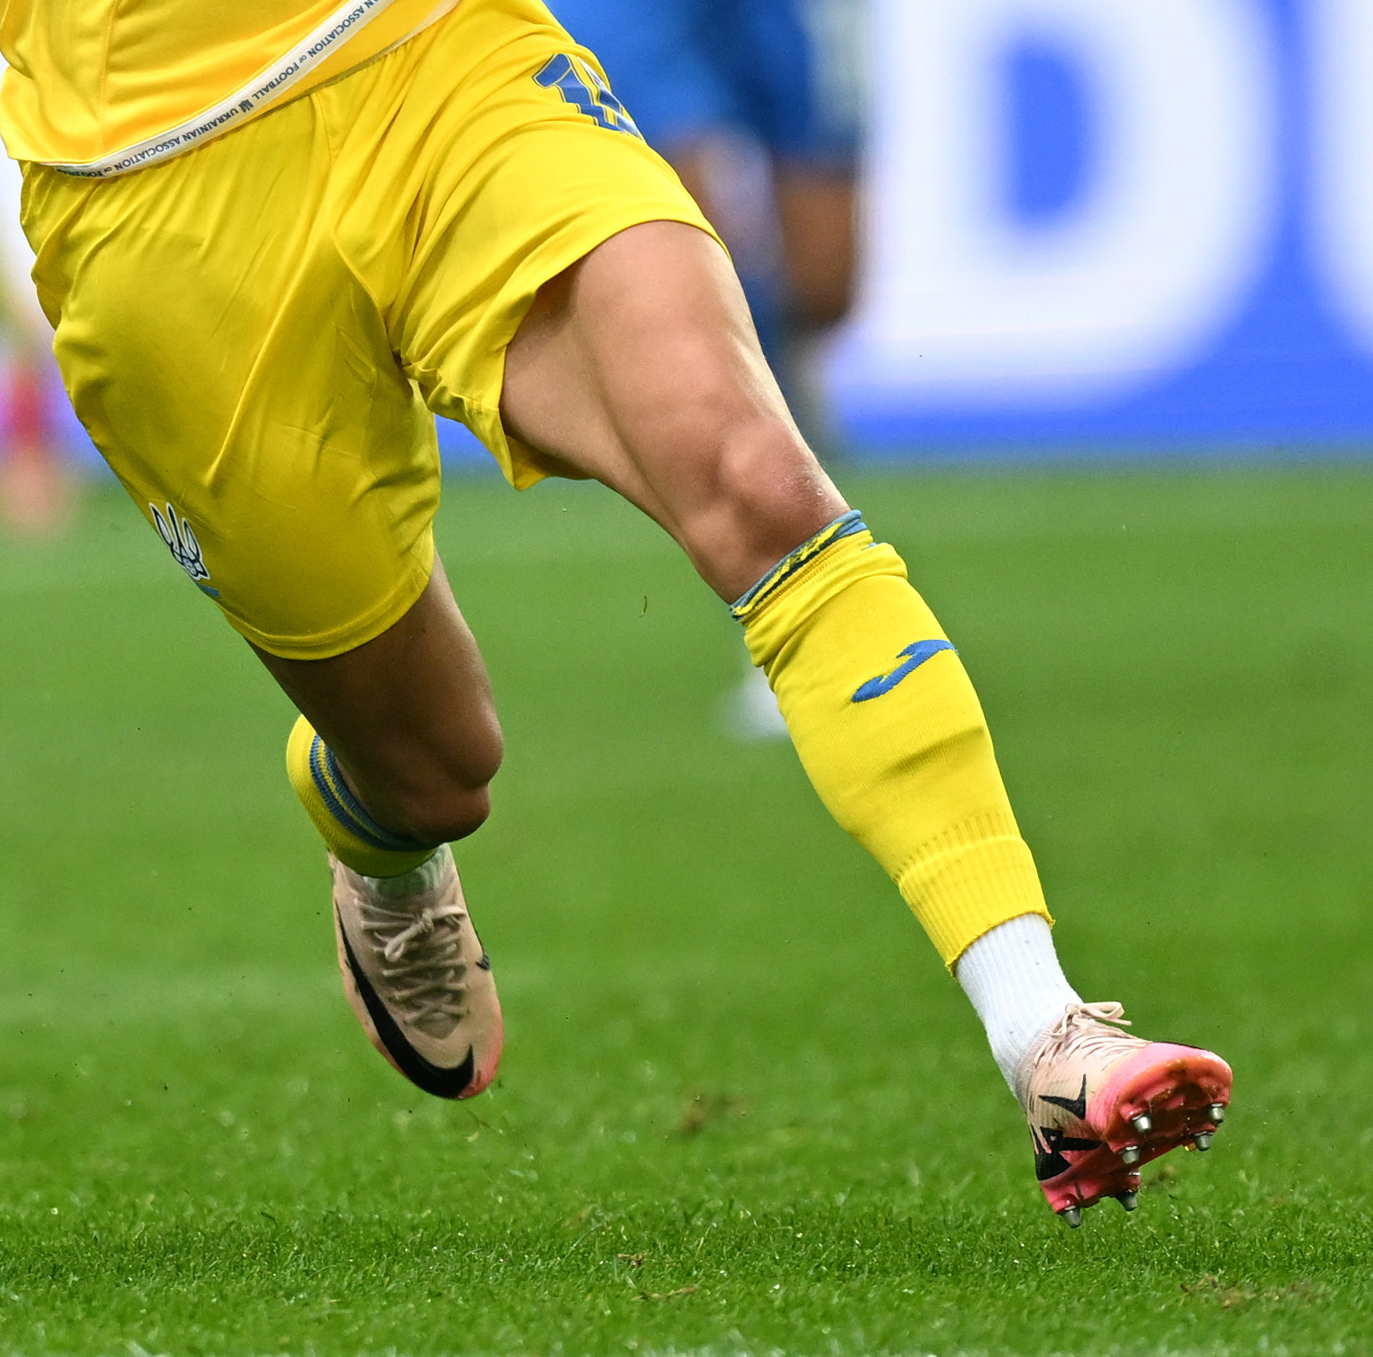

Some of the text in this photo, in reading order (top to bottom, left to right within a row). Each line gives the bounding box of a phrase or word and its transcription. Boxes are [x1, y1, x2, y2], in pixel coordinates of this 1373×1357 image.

[307, 5, 366, 58] ASSOCIATION
[251, 62, 300, 101] FOOTBALL
[183, 108, 239, 142] UKRAINIAN
[115, 137, 182, 171] ASSOCIATION
